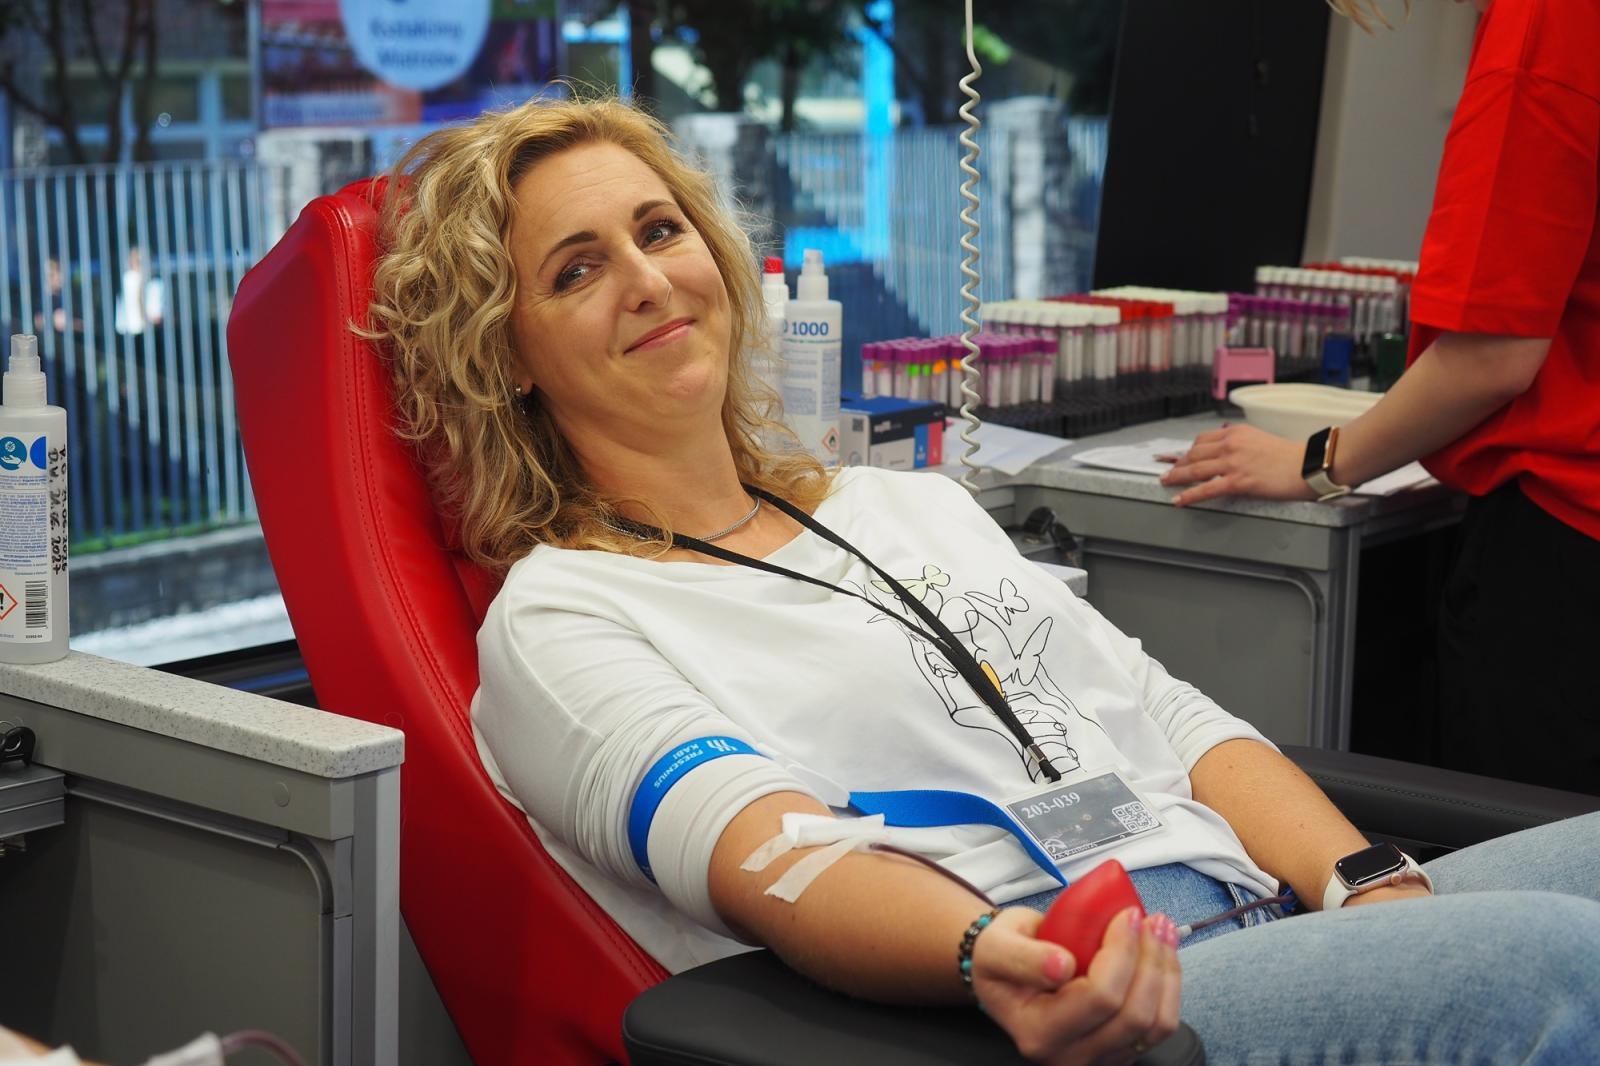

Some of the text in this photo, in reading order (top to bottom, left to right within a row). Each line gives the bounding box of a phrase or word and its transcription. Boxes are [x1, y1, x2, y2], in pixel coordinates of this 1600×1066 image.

[791, 322, 829, 336] 1000
[672, 743, 700, 760] KABI
[653, 749, 704, 789] FRESENIUS
[1021, 791, 1081, 819] 203-039
